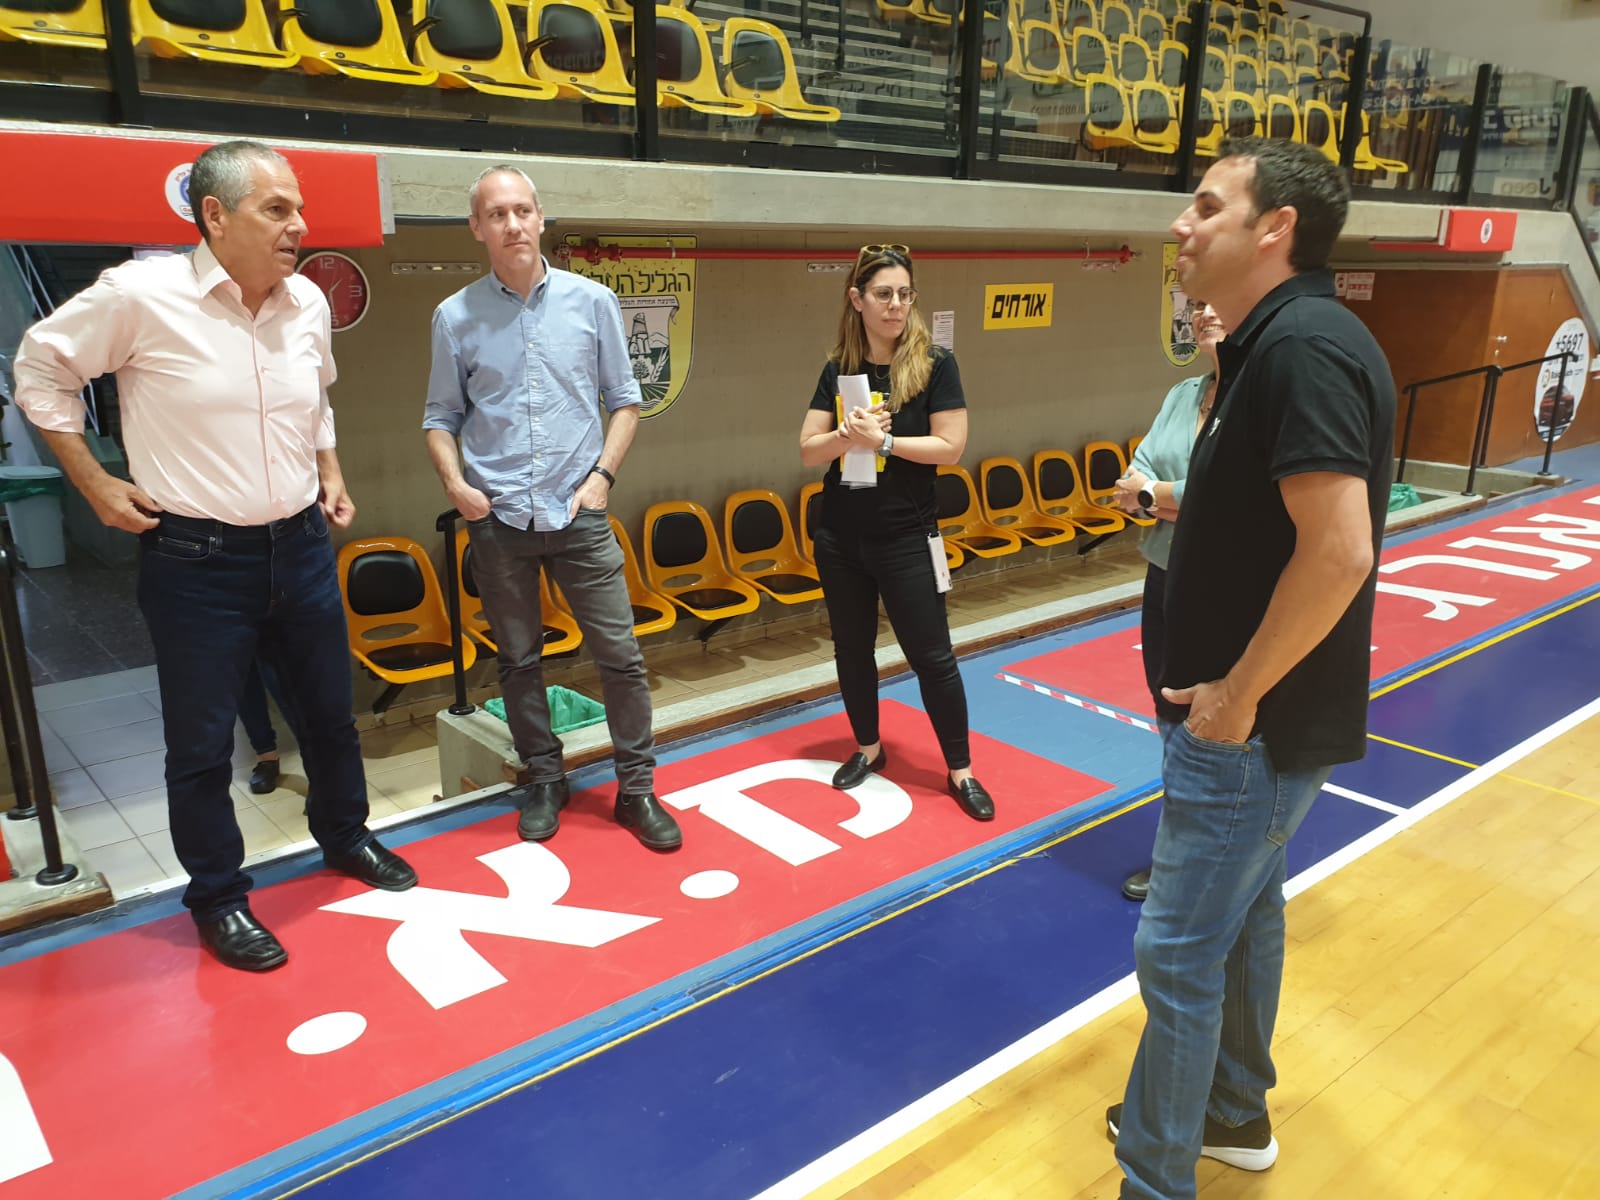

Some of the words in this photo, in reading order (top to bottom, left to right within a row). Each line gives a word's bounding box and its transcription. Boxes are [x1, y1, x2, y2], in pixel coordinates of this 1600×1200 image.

[319, 256, 335, 269] 12
[638, 270, 691, 294] הגליל
[991, 293, 1047, 319] אורחים
